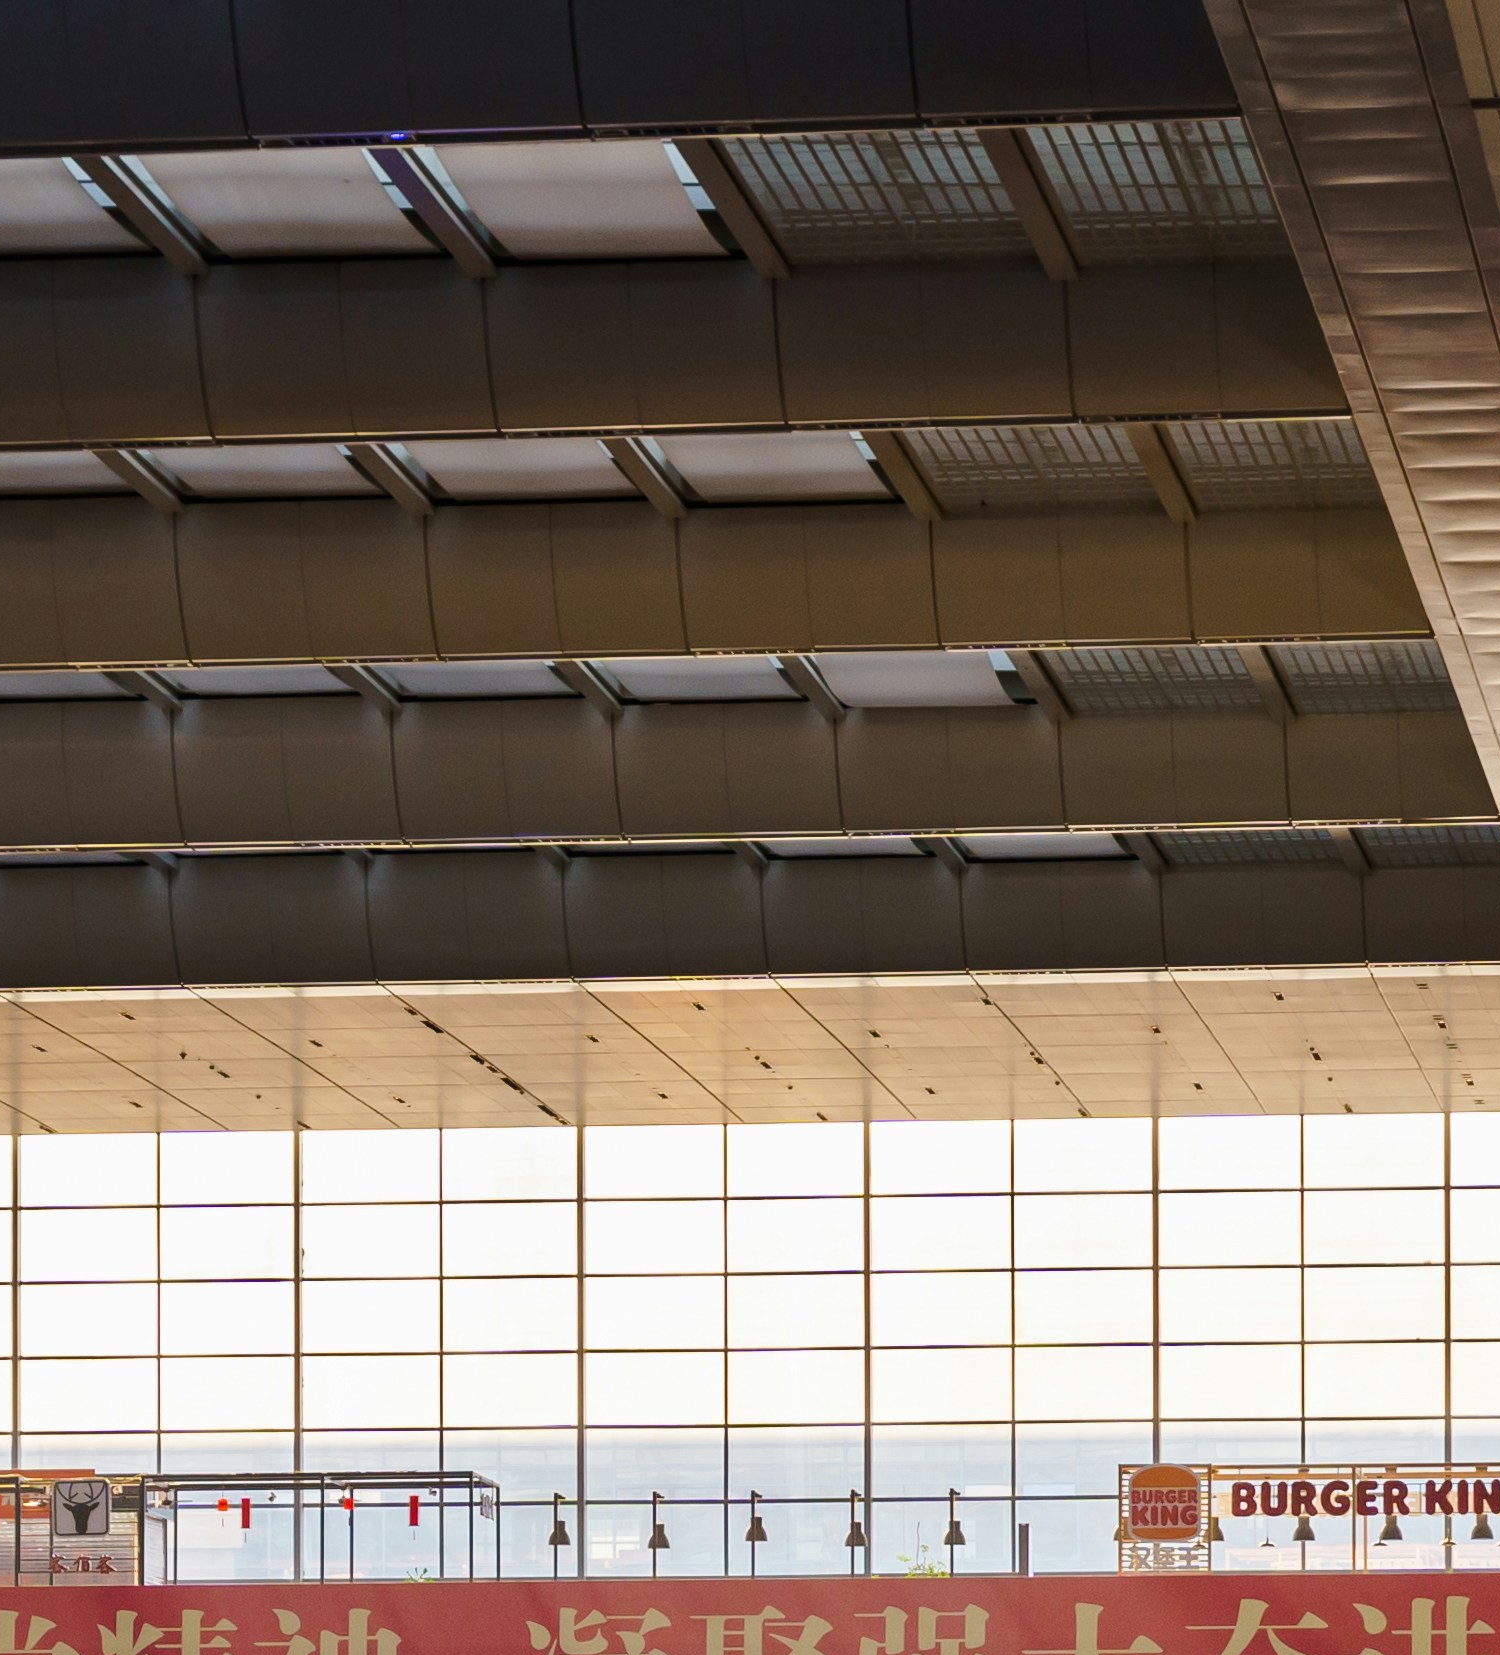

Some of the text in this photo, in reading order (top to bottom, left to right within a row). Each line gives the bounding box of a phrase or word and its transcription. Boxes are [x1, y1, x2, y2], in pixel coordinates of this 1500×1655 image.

[1131, 1489, 1198, 1527] BURGER KING
[1231, 1480, 1410, 1518] BURGER
